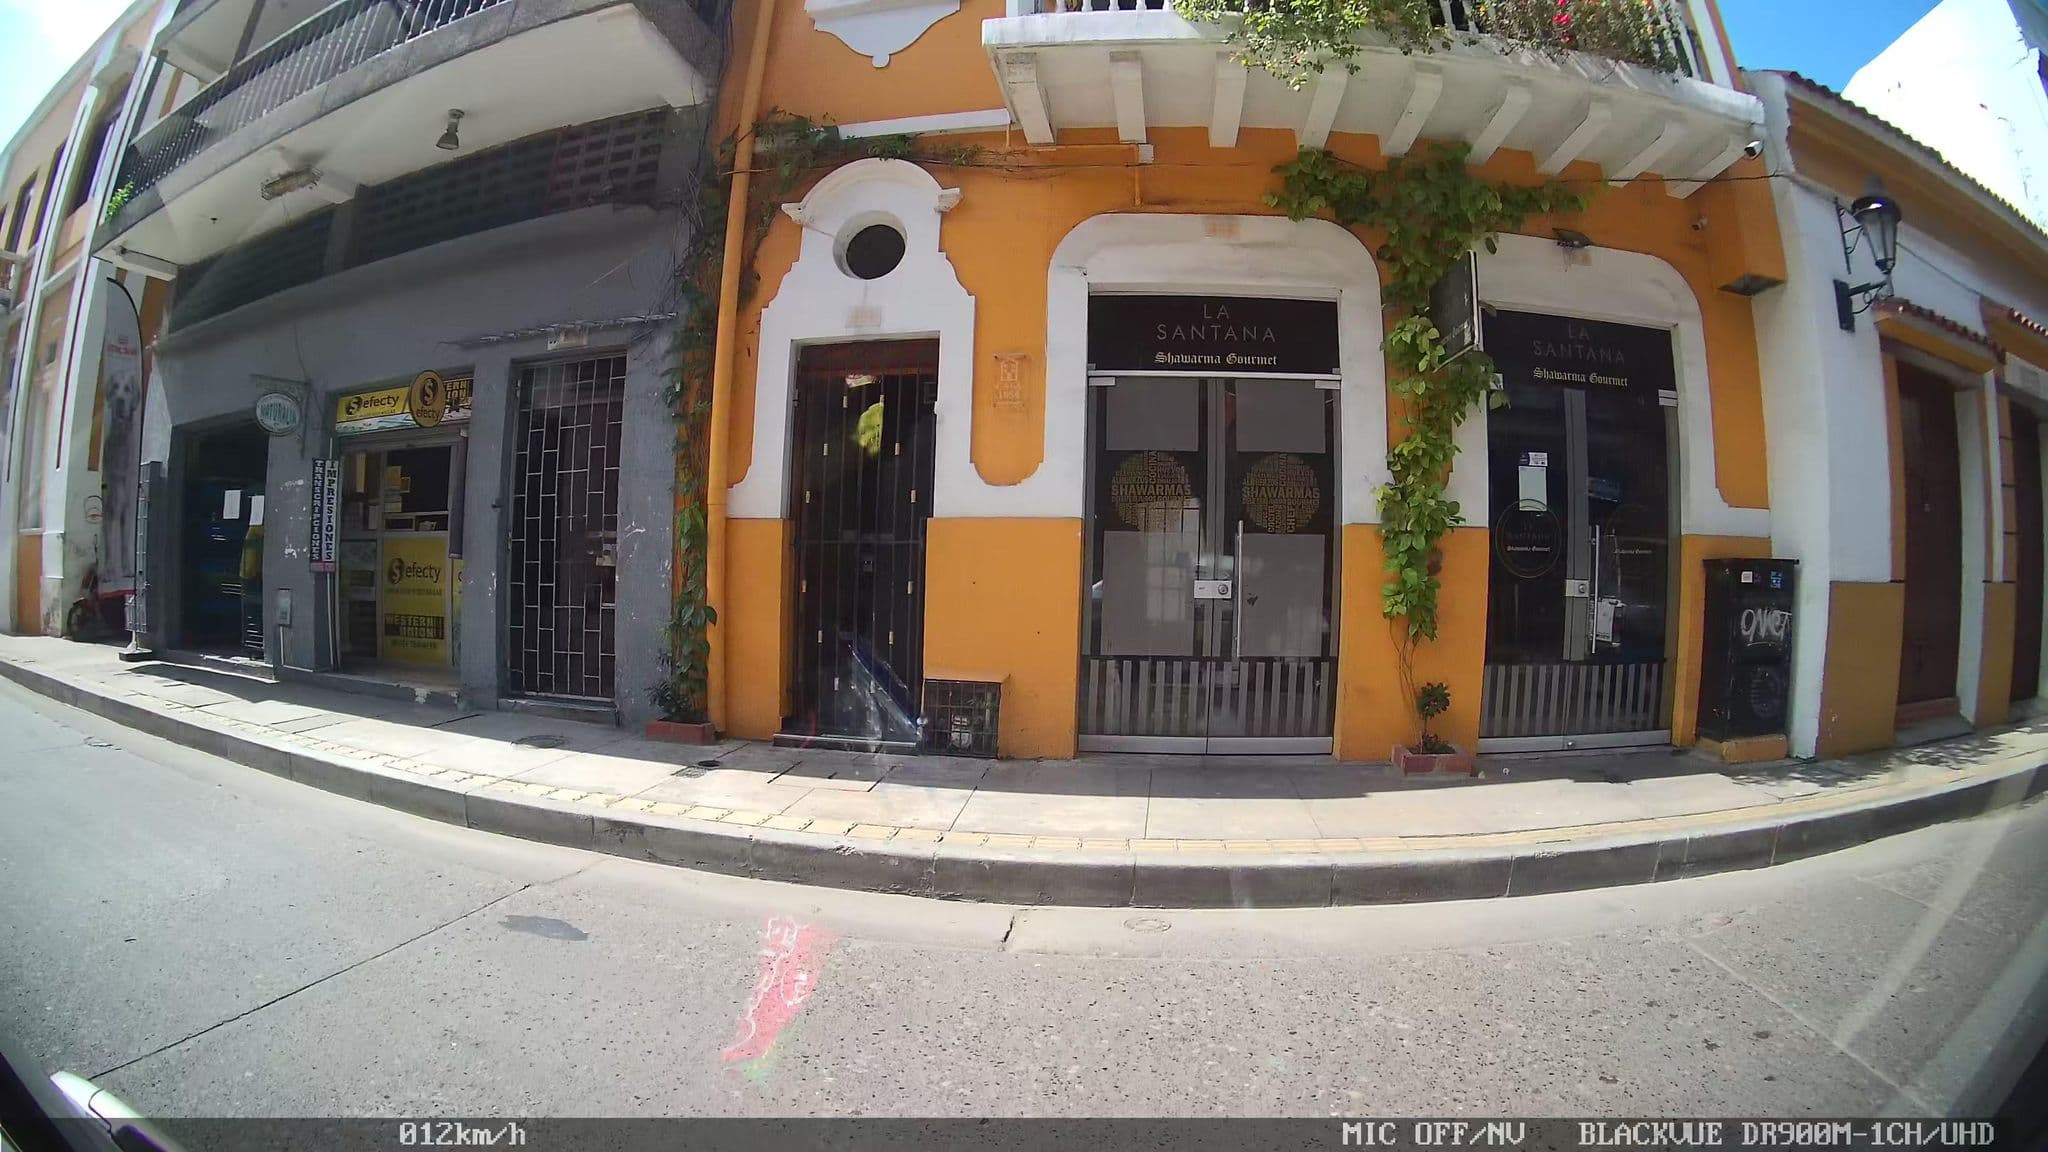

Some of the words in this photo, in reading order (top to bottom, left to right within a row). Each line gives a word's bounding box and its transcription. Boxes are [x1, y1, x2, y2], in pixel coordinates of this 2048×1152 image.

[1203, 303, 1230, 320] LA
[1156, 324, 1277, 344] SANTANA
[1567, 322, 1591, 340] LA
[1154, 351, 1222, 366] Shawarma
[1226, 352, 1278, 366] Gourmet
[1532, 339, 1626, 364] SANTANA
[1533, 366, 1586, 384] Shawarma
[1589, 372, 1629, 388] Gourmet
[362, 394, 400, 411] efecty
[416, 406, 441, 421] efecty
[1111, 484, 1192, 496] SHAWARMAS
[1241, 487, 1320, 499] SHAWARMAS
[324, 459, 337, 561] IMPRESIONES
[405, 562, 441, 583] efecty
[384, 615, 434, 627] WESTERN
